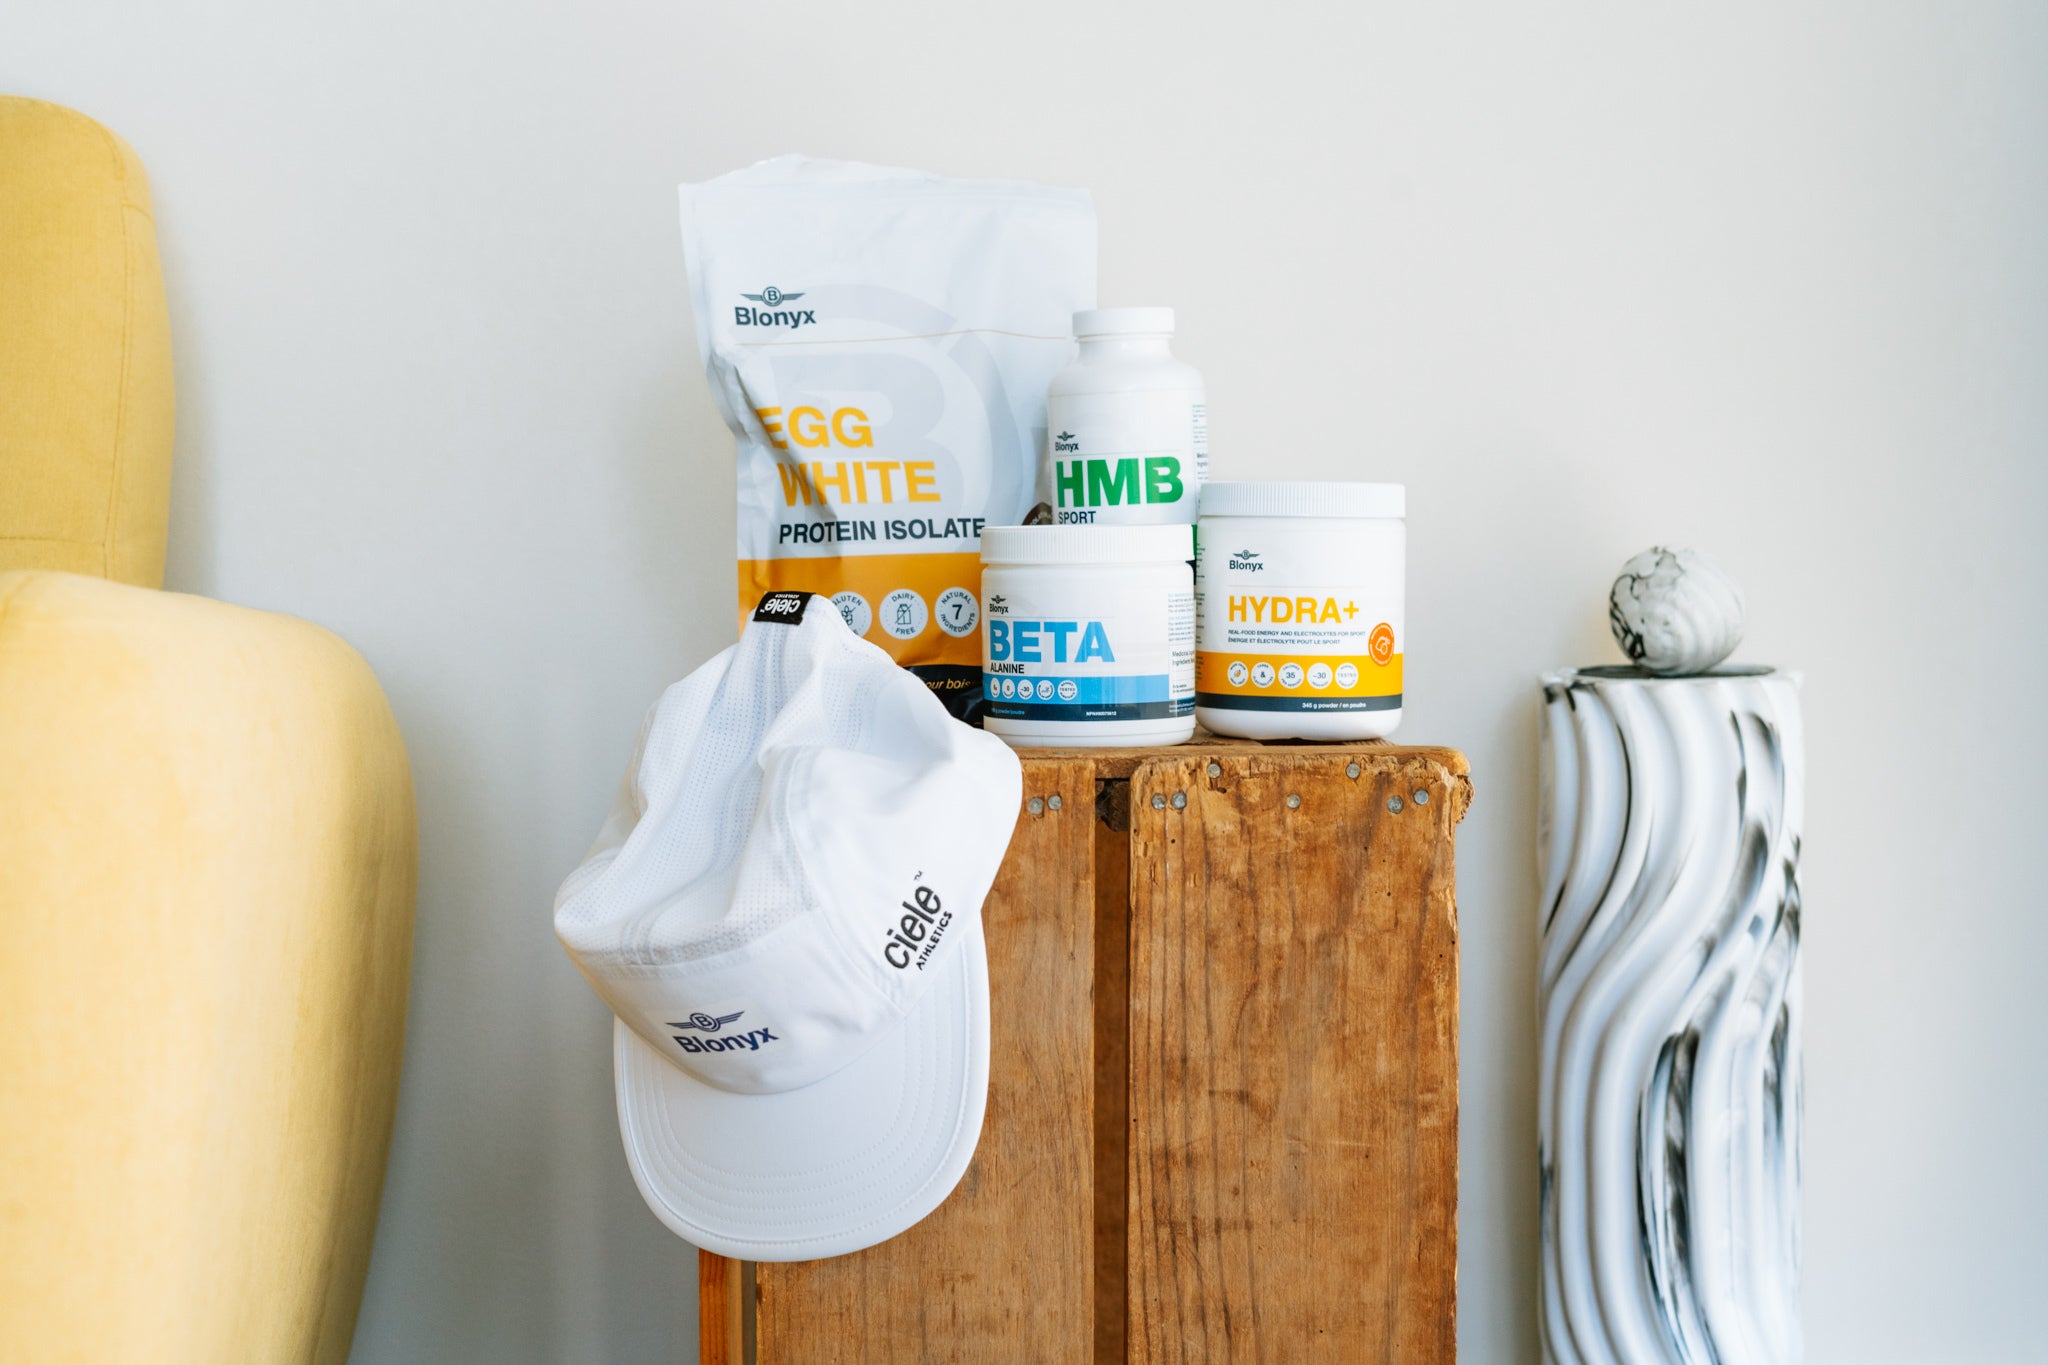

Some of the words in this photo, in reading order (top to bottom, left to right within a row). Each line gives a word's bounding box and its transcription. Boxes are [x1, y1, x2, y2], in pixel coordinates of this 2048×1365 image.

[735, 306, 816, 329] Blonyx
[755, 406, 874, 449] EGG
[1055, 441, 1079, 453] Blonyx
[777, 461, 941, 507] WHITE
[1056, 456, 1184, 508] HMB
[1058, 511, 1097, 524] SPORT
[779, 520, 877, 544] PROTEIN
[883, 517, 986, 541] ISOLATE
[1229, 559, 1263, 572] Blonyx
[891, 592, 915, 603] DAIRY
[941, 591, 972, 605] NATURAL
[952, 604, 963, 620] 7
[989, 603, 1009, 615] Blonyx
[1228, 595, 1360, 624] HYDRA+
[895, 626, 916, 635] FREE
[940, 612, 976, 633] INGREDIENTS
[990, 619, 1116, 663] BETA
[990, 662, 1025, 674] ALANINE
[1285, 671, 1296, 679] 35
[884, 886, 942, 969] ciele
[916, 911, 953, 971] ATHLETICS
[673, 1027, 780, 1053] Blonyx
